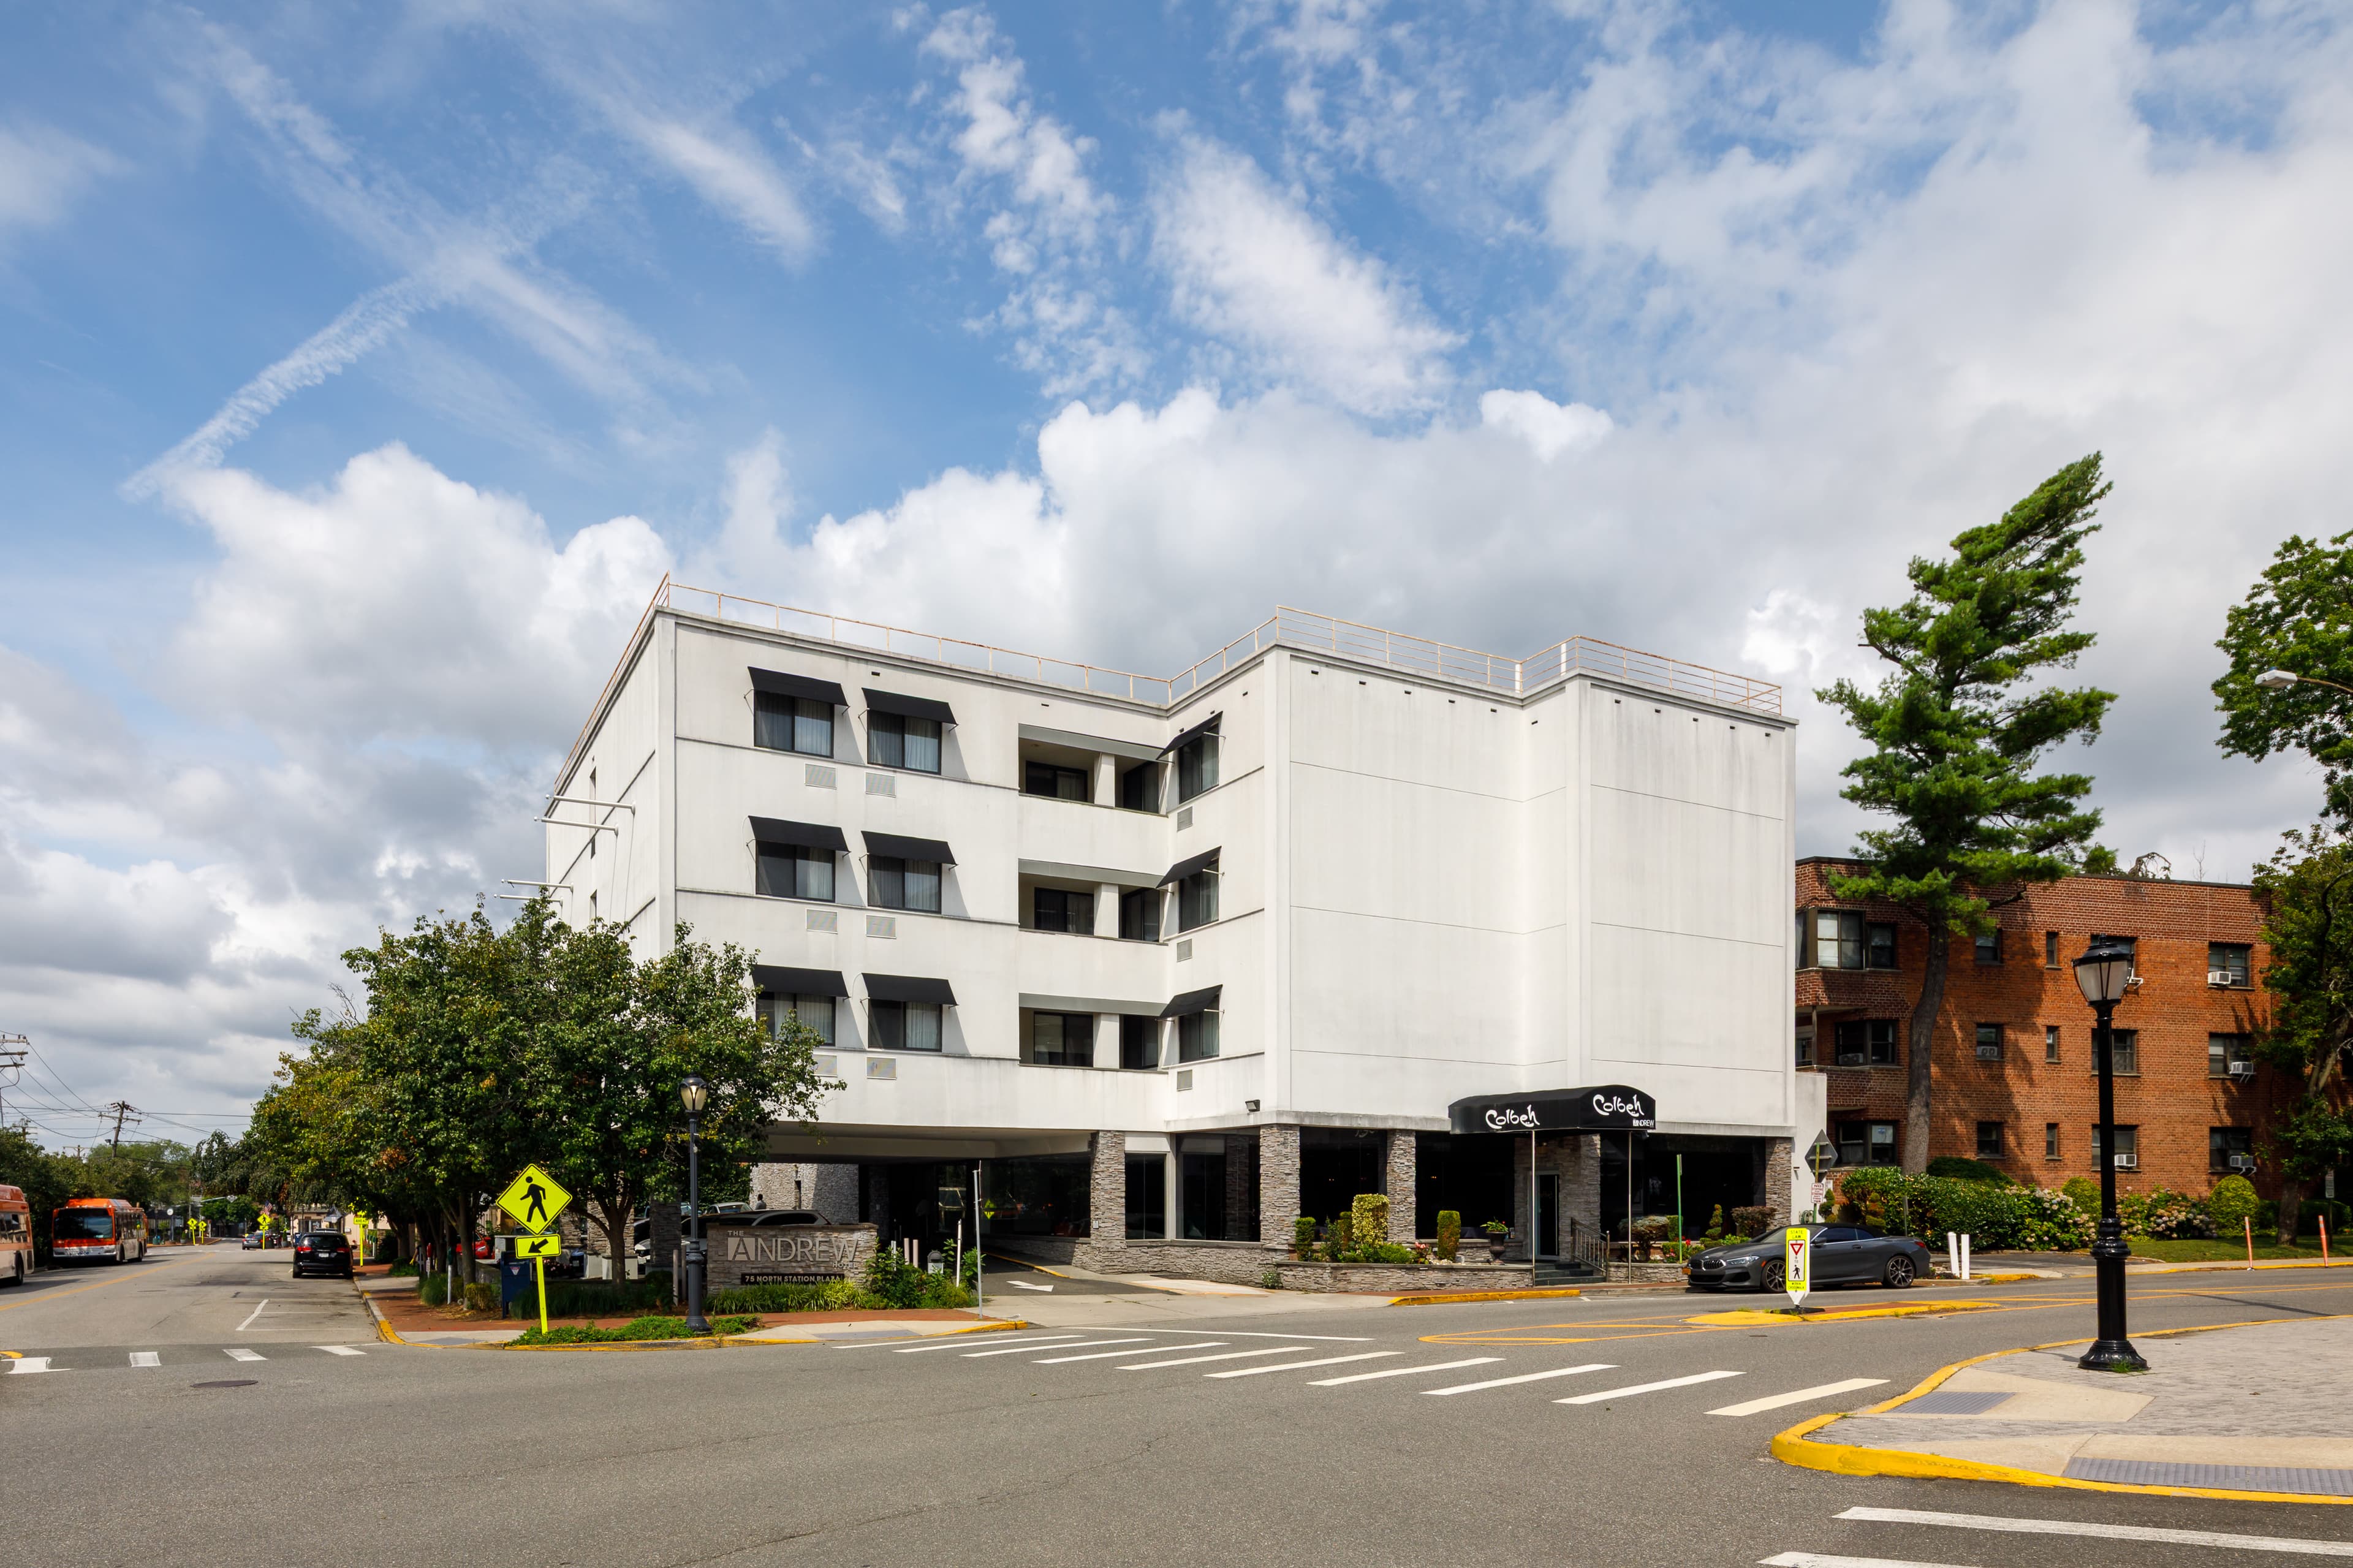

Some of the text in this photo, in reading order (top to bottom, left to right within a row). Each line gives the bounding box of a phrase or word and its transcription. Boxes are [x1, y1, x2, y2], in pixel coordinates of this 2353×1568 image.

[1485, 1104, 1540, 1129] Colbeh
[1593, 1094, 1645, 1117] Colbeh
[727, 1237, 858, 1261] ANDREW
